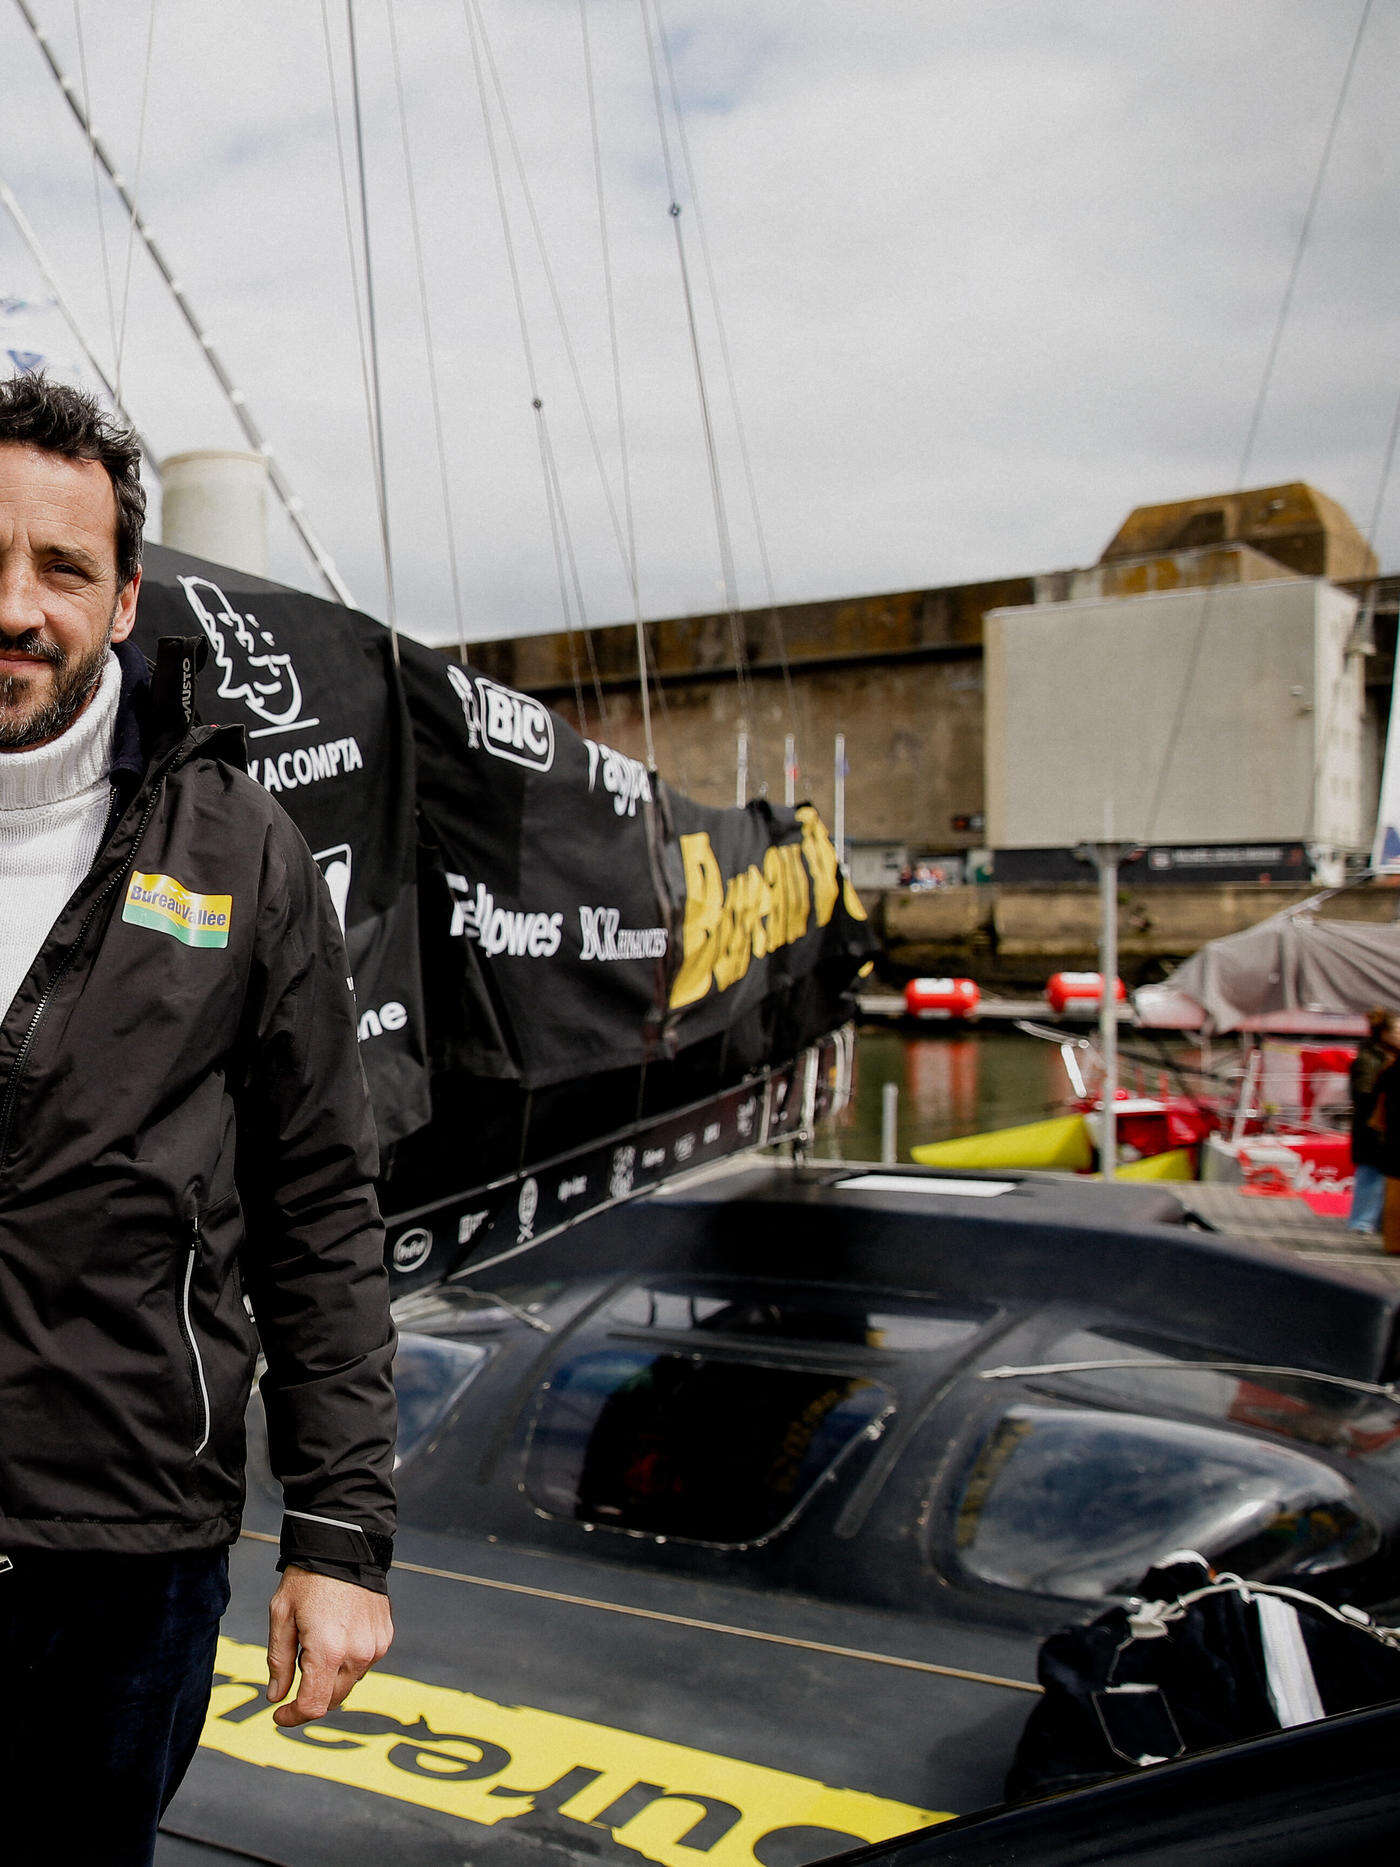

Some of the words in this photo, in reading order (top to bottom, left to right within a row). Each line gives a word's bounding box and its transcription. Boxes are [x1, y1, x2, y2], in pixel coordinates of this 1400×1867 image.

[182, 657, 192, 722] MUSTO
[485, 688, 548, 756] BIC
[356, 1001, 408, 1043] ne
